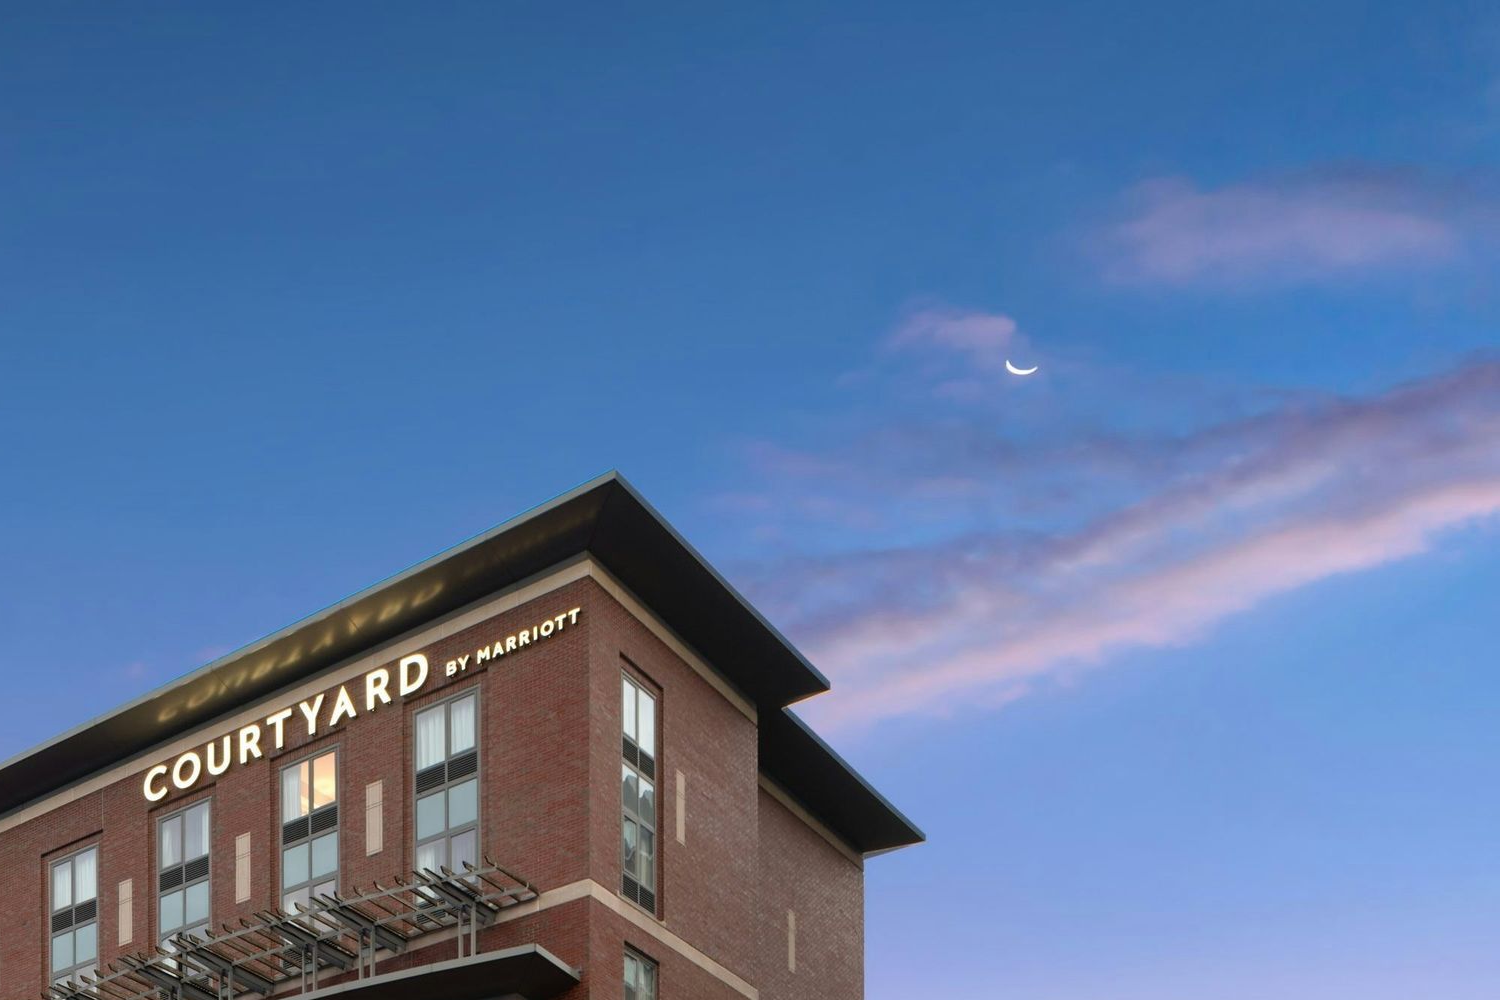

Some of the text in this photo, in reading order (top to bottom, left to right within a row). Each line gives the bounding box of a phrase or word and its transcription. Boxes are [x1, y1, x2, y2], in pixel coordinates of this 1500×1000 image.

[142, 607, 581, 803] COURTYARD BY MARRIOTT
